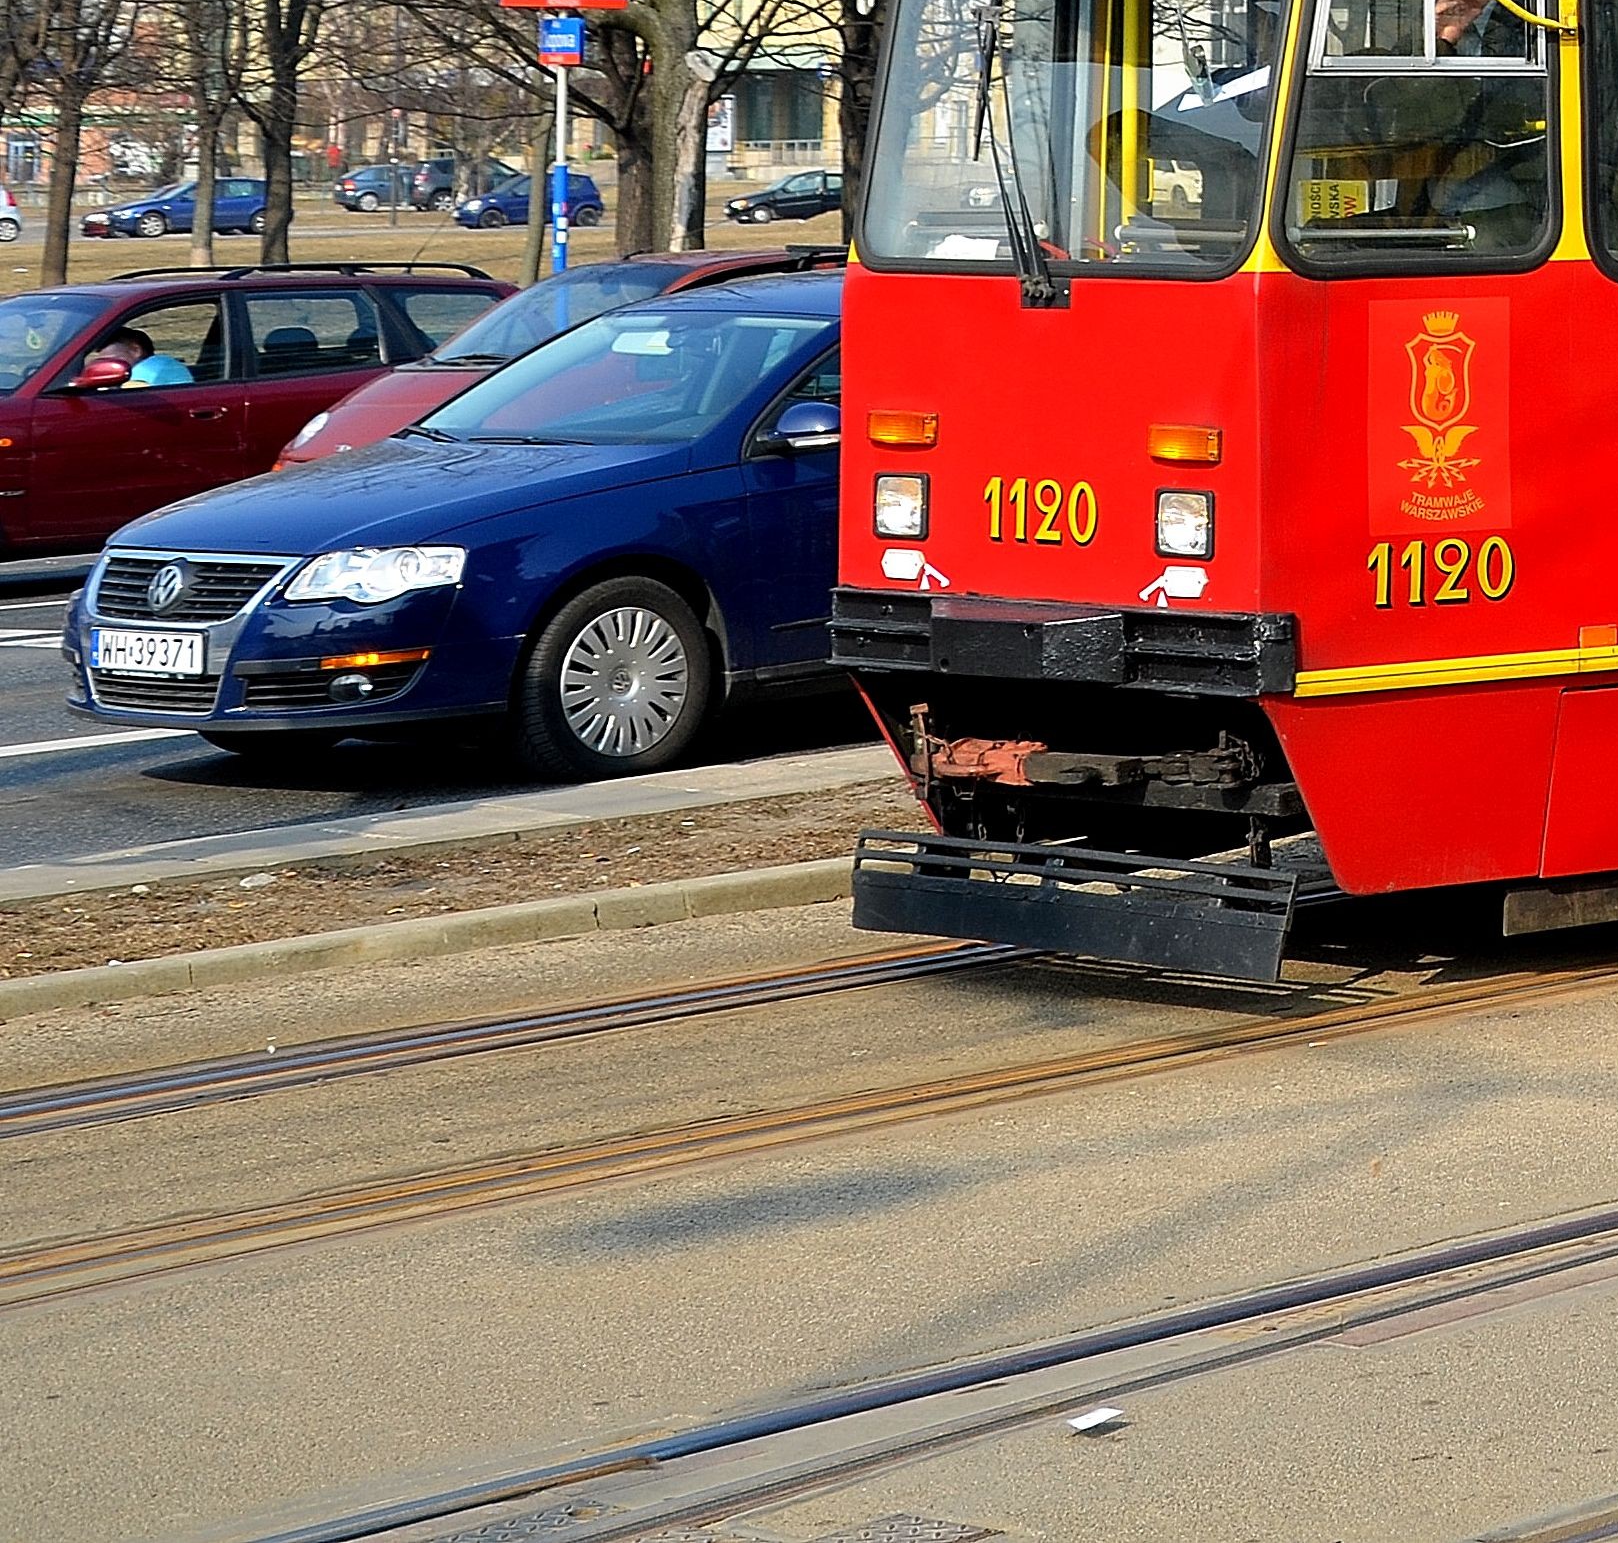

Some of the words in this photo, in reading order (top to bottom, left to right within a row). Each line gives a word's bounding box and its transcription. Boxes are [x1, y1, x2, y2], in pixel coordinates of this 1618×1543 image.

[984, 476, 1098, 546] 1120
[1400, 498, 1486, 521] WARSZAWSKIE
[1411, 488, 1476, 508] TRAMWAJE
[1367, 535, 1516, 608] 1120
[102, 634, 127, 664] WH
[134, 637, 194, 668] 39371
